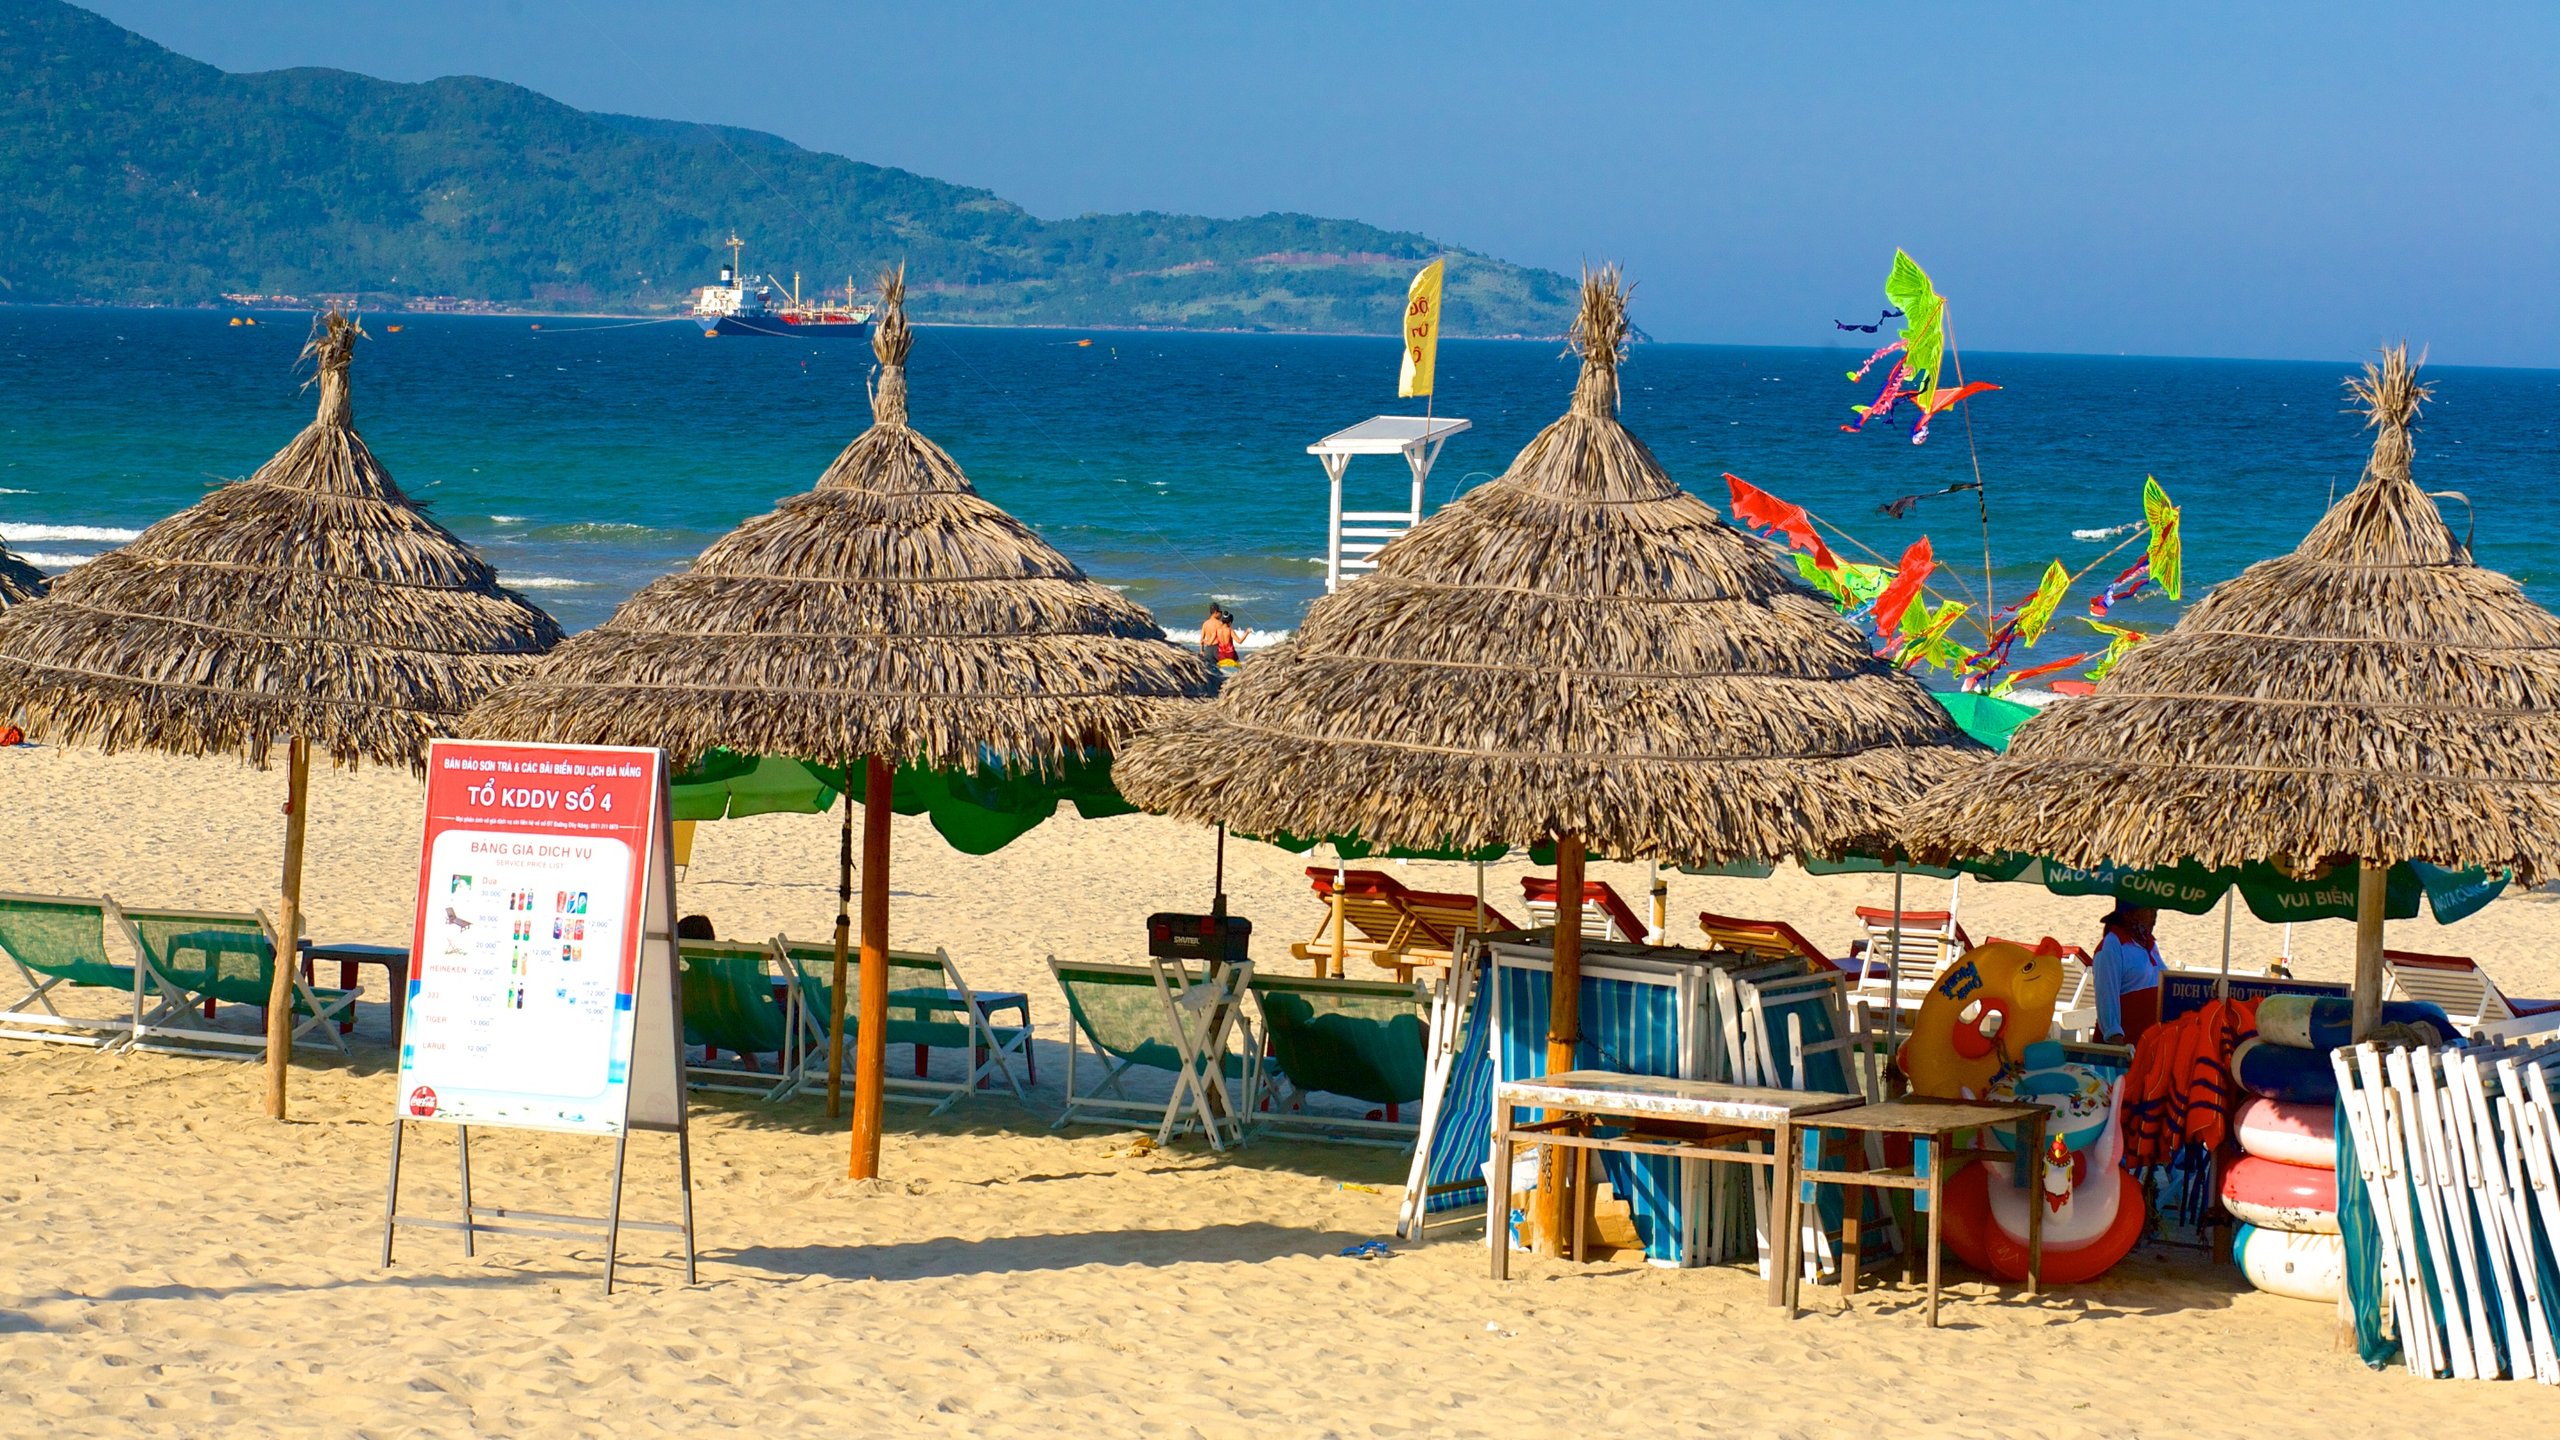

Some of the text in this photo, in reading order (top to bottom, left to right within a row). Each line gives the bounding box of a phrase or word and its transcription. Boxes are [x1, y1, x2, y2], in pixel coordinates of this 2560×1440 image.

[461, 756, 479, 771] ĐẢO
[479, 760, 496, 772] SƠN
[497, 759, 512, 773] TRÀ
[513, 762, 520, 773] &
[521, 760, 538, 774] CÁC
[574, 764, 586, 776] DU
[586, 765, 605, 778] LỊCH
[467, 778, 612, 812] TỔ KDDV SỐ 4
[496, 859, 524, 868] SERVICE
[2180, 885, 2207, 902] UP
[2277, 892, 2310, 909] VUI
[1173, 936, 1200, 945] SHUTER
[429, 964, 467, 974] HEINEKEN
[2172, 983, 2201, 999] DỊCH
[2229, 986, 2245, 1001] HO
[425, 1015, 447, 1023] TIGER
[422, 1042, 446, 1050] LARUE
